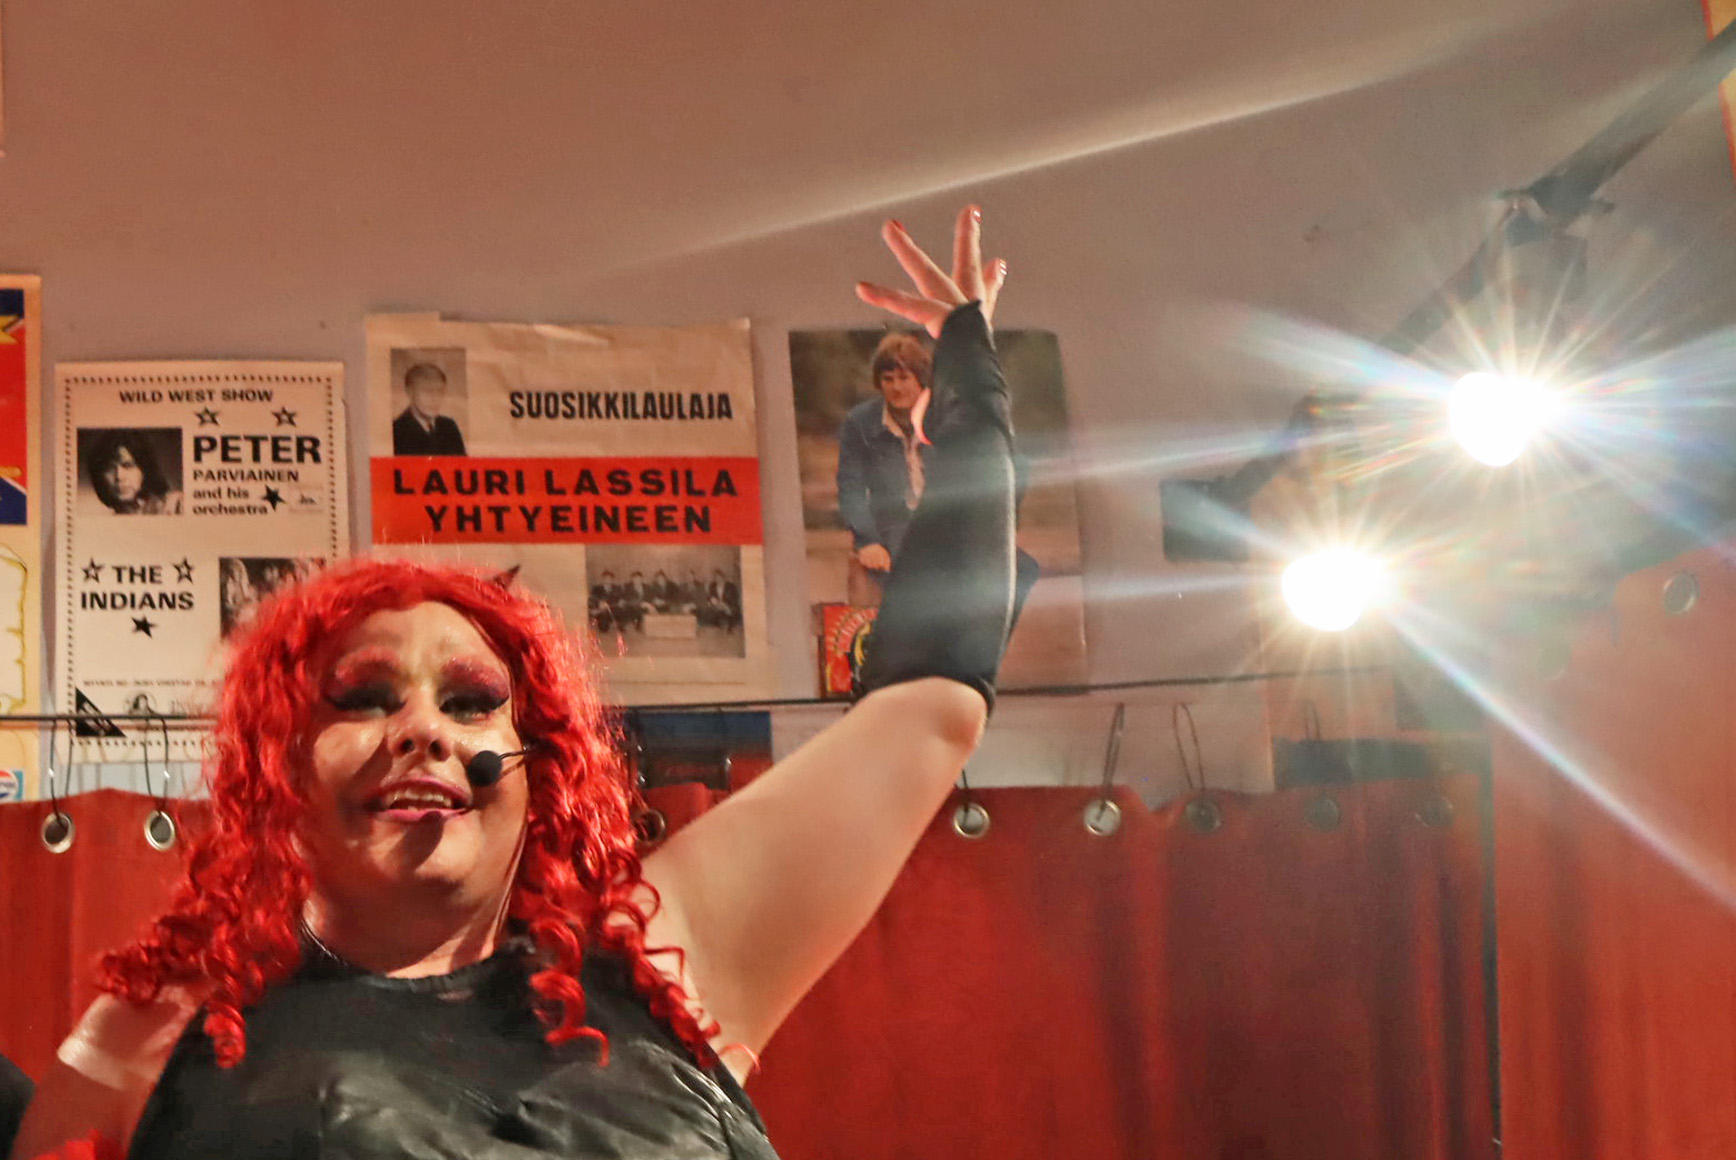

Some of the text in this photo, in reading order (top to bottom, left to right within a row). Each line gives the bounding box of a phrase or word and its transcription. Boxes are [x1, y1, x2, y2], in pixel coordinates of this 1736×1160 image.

[119, 389, 273, 404] WILD WEST SHOW
[509, 391, 733, 421] SUOSIKKILAULAJA
[193, 435, 322, 464] PETER
[193, 469, 299, 482] PARVIAINEN
[393, 468, 738, 497] LAURI LASSILA
[193, 486, 250, 499] and his
[193, 503, 268, 515] orchestra
[425, 505, 712, 533] YHTYEINEEN
[114, 565, 163, 584] THE
[80, 591, 195, 611] INDIANS
